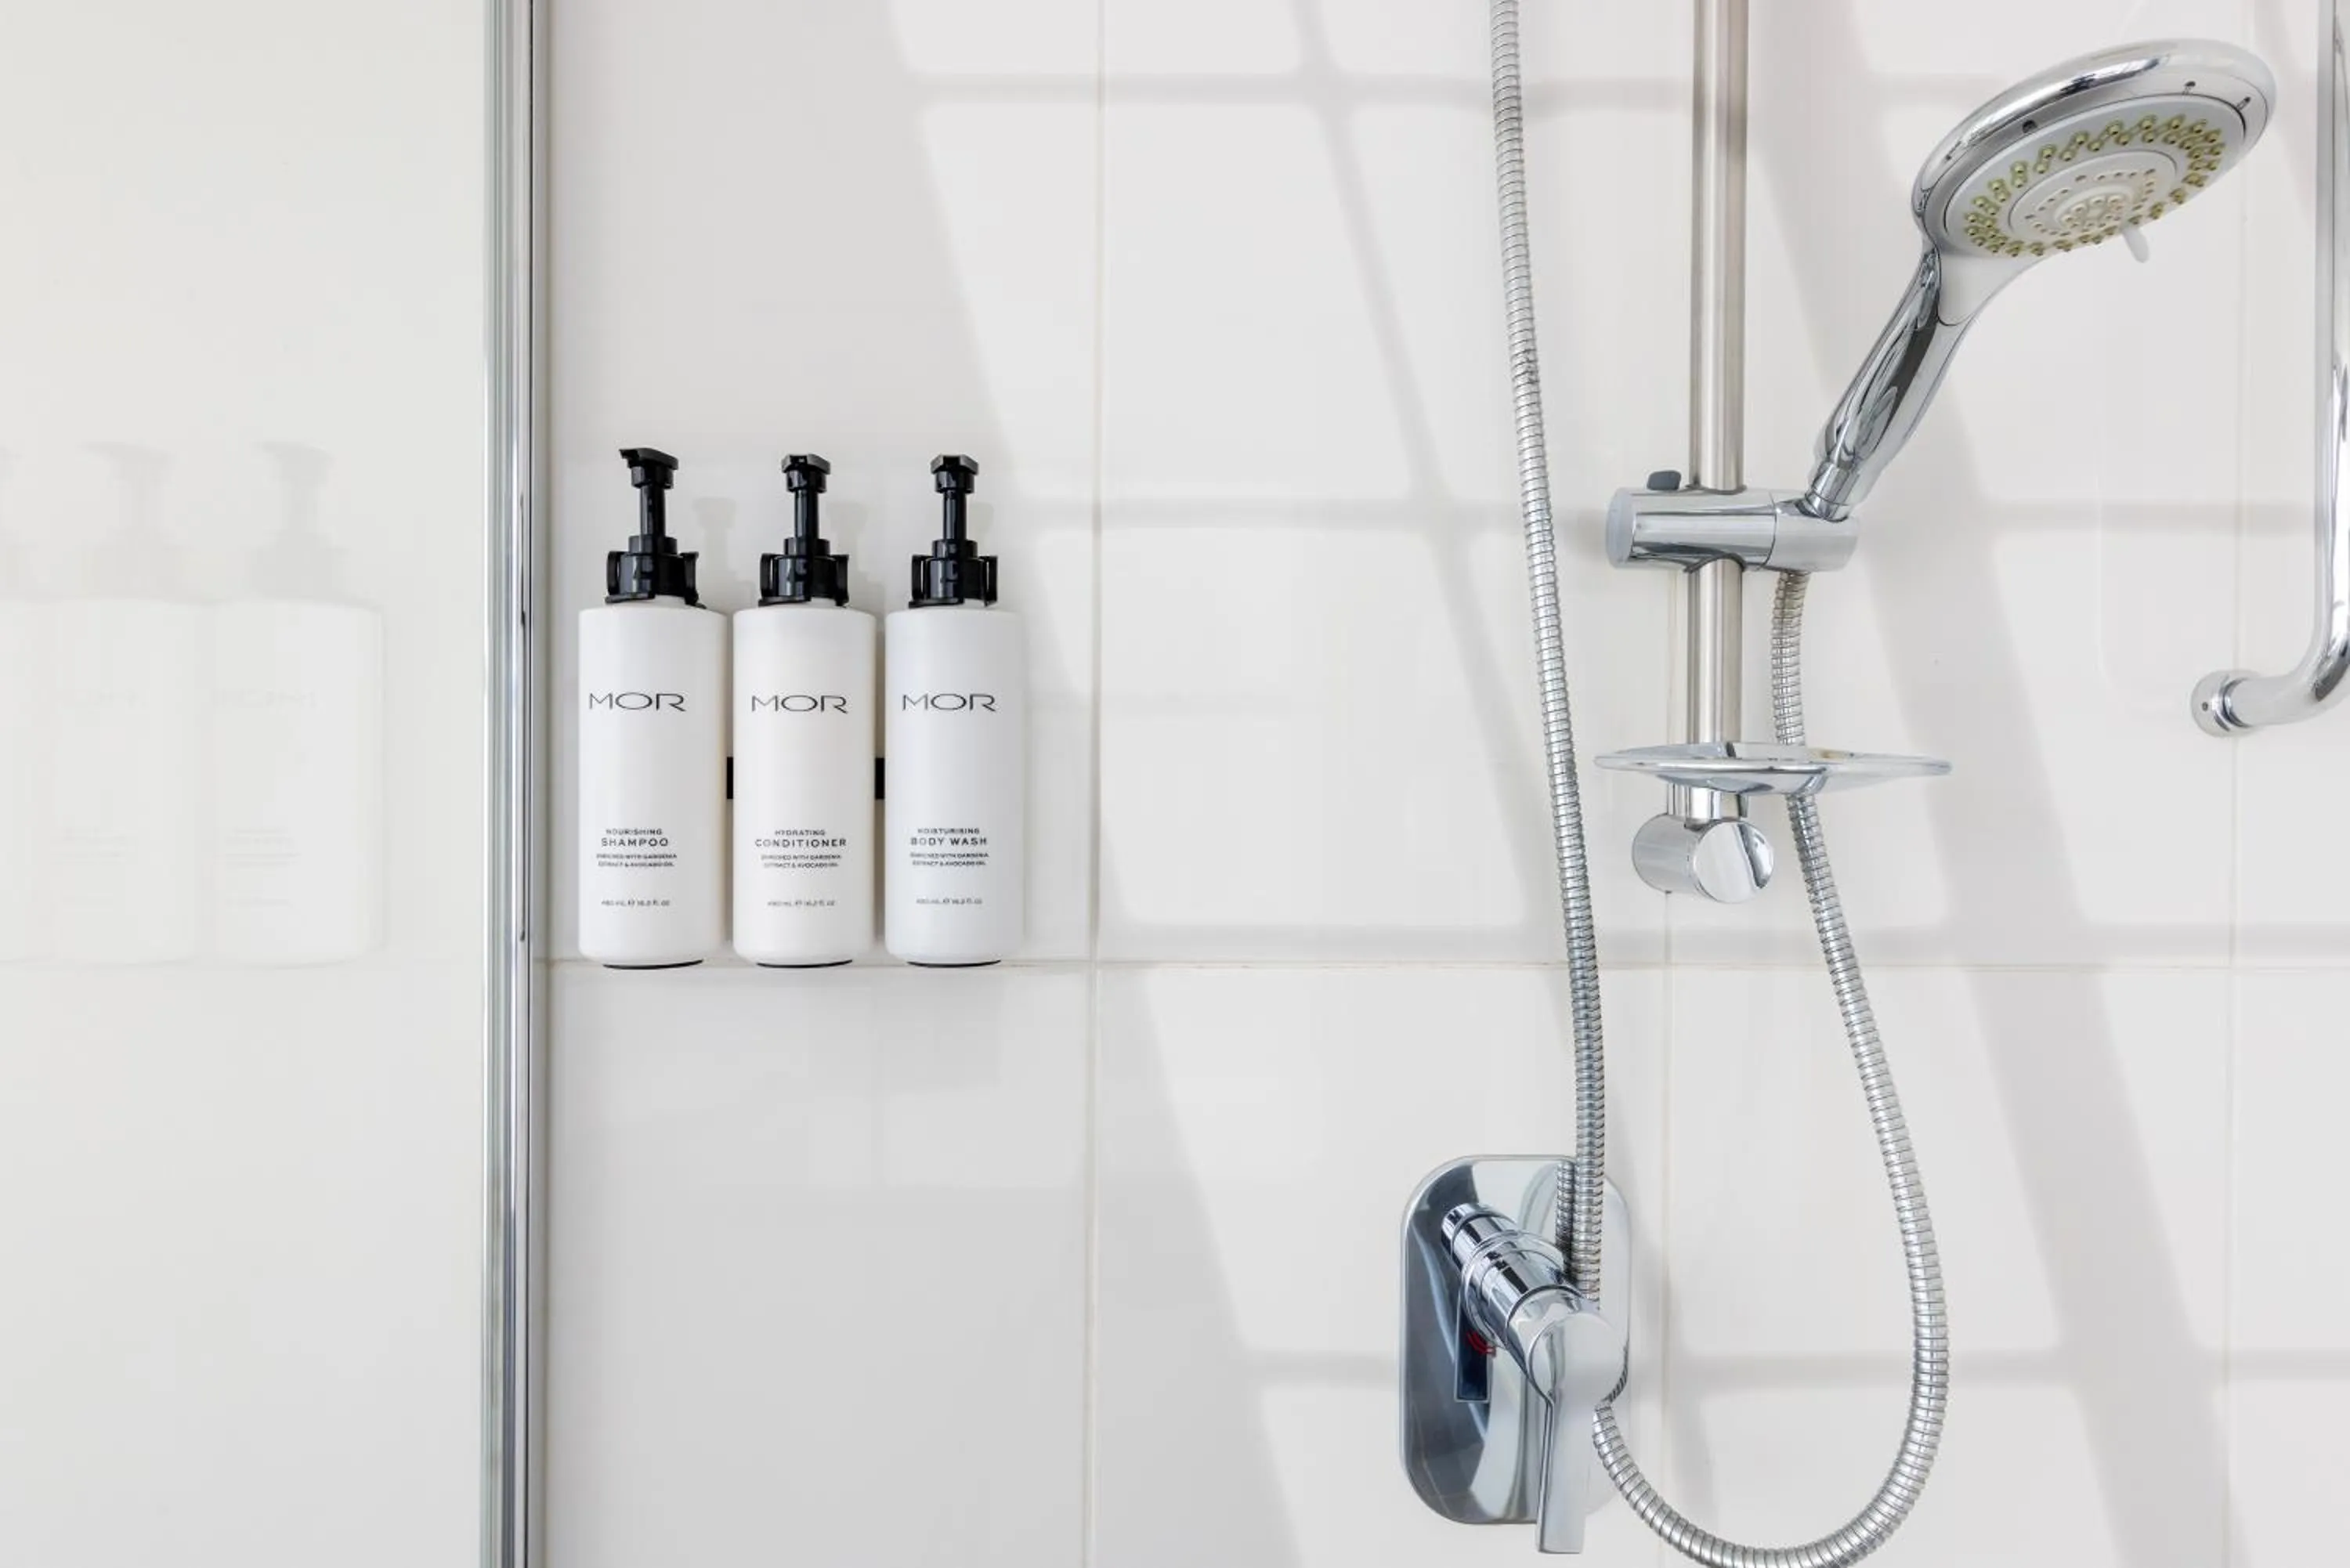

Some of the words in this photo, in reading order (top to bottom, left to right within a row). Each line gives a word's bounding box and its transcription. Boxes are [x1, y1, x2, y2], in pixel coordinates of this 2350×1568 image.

[589, 692, 688, 712] MOR
[751, 694, 849, 714] MOR
[902, 692, 1000, 713] MOR
[601, 837, 669, 847] SHAMPOO
[754, 839, 847, 847] CONDITIONER
[910, 837, 945, 846] BODY
[949, 837, 988, 846] WASH
